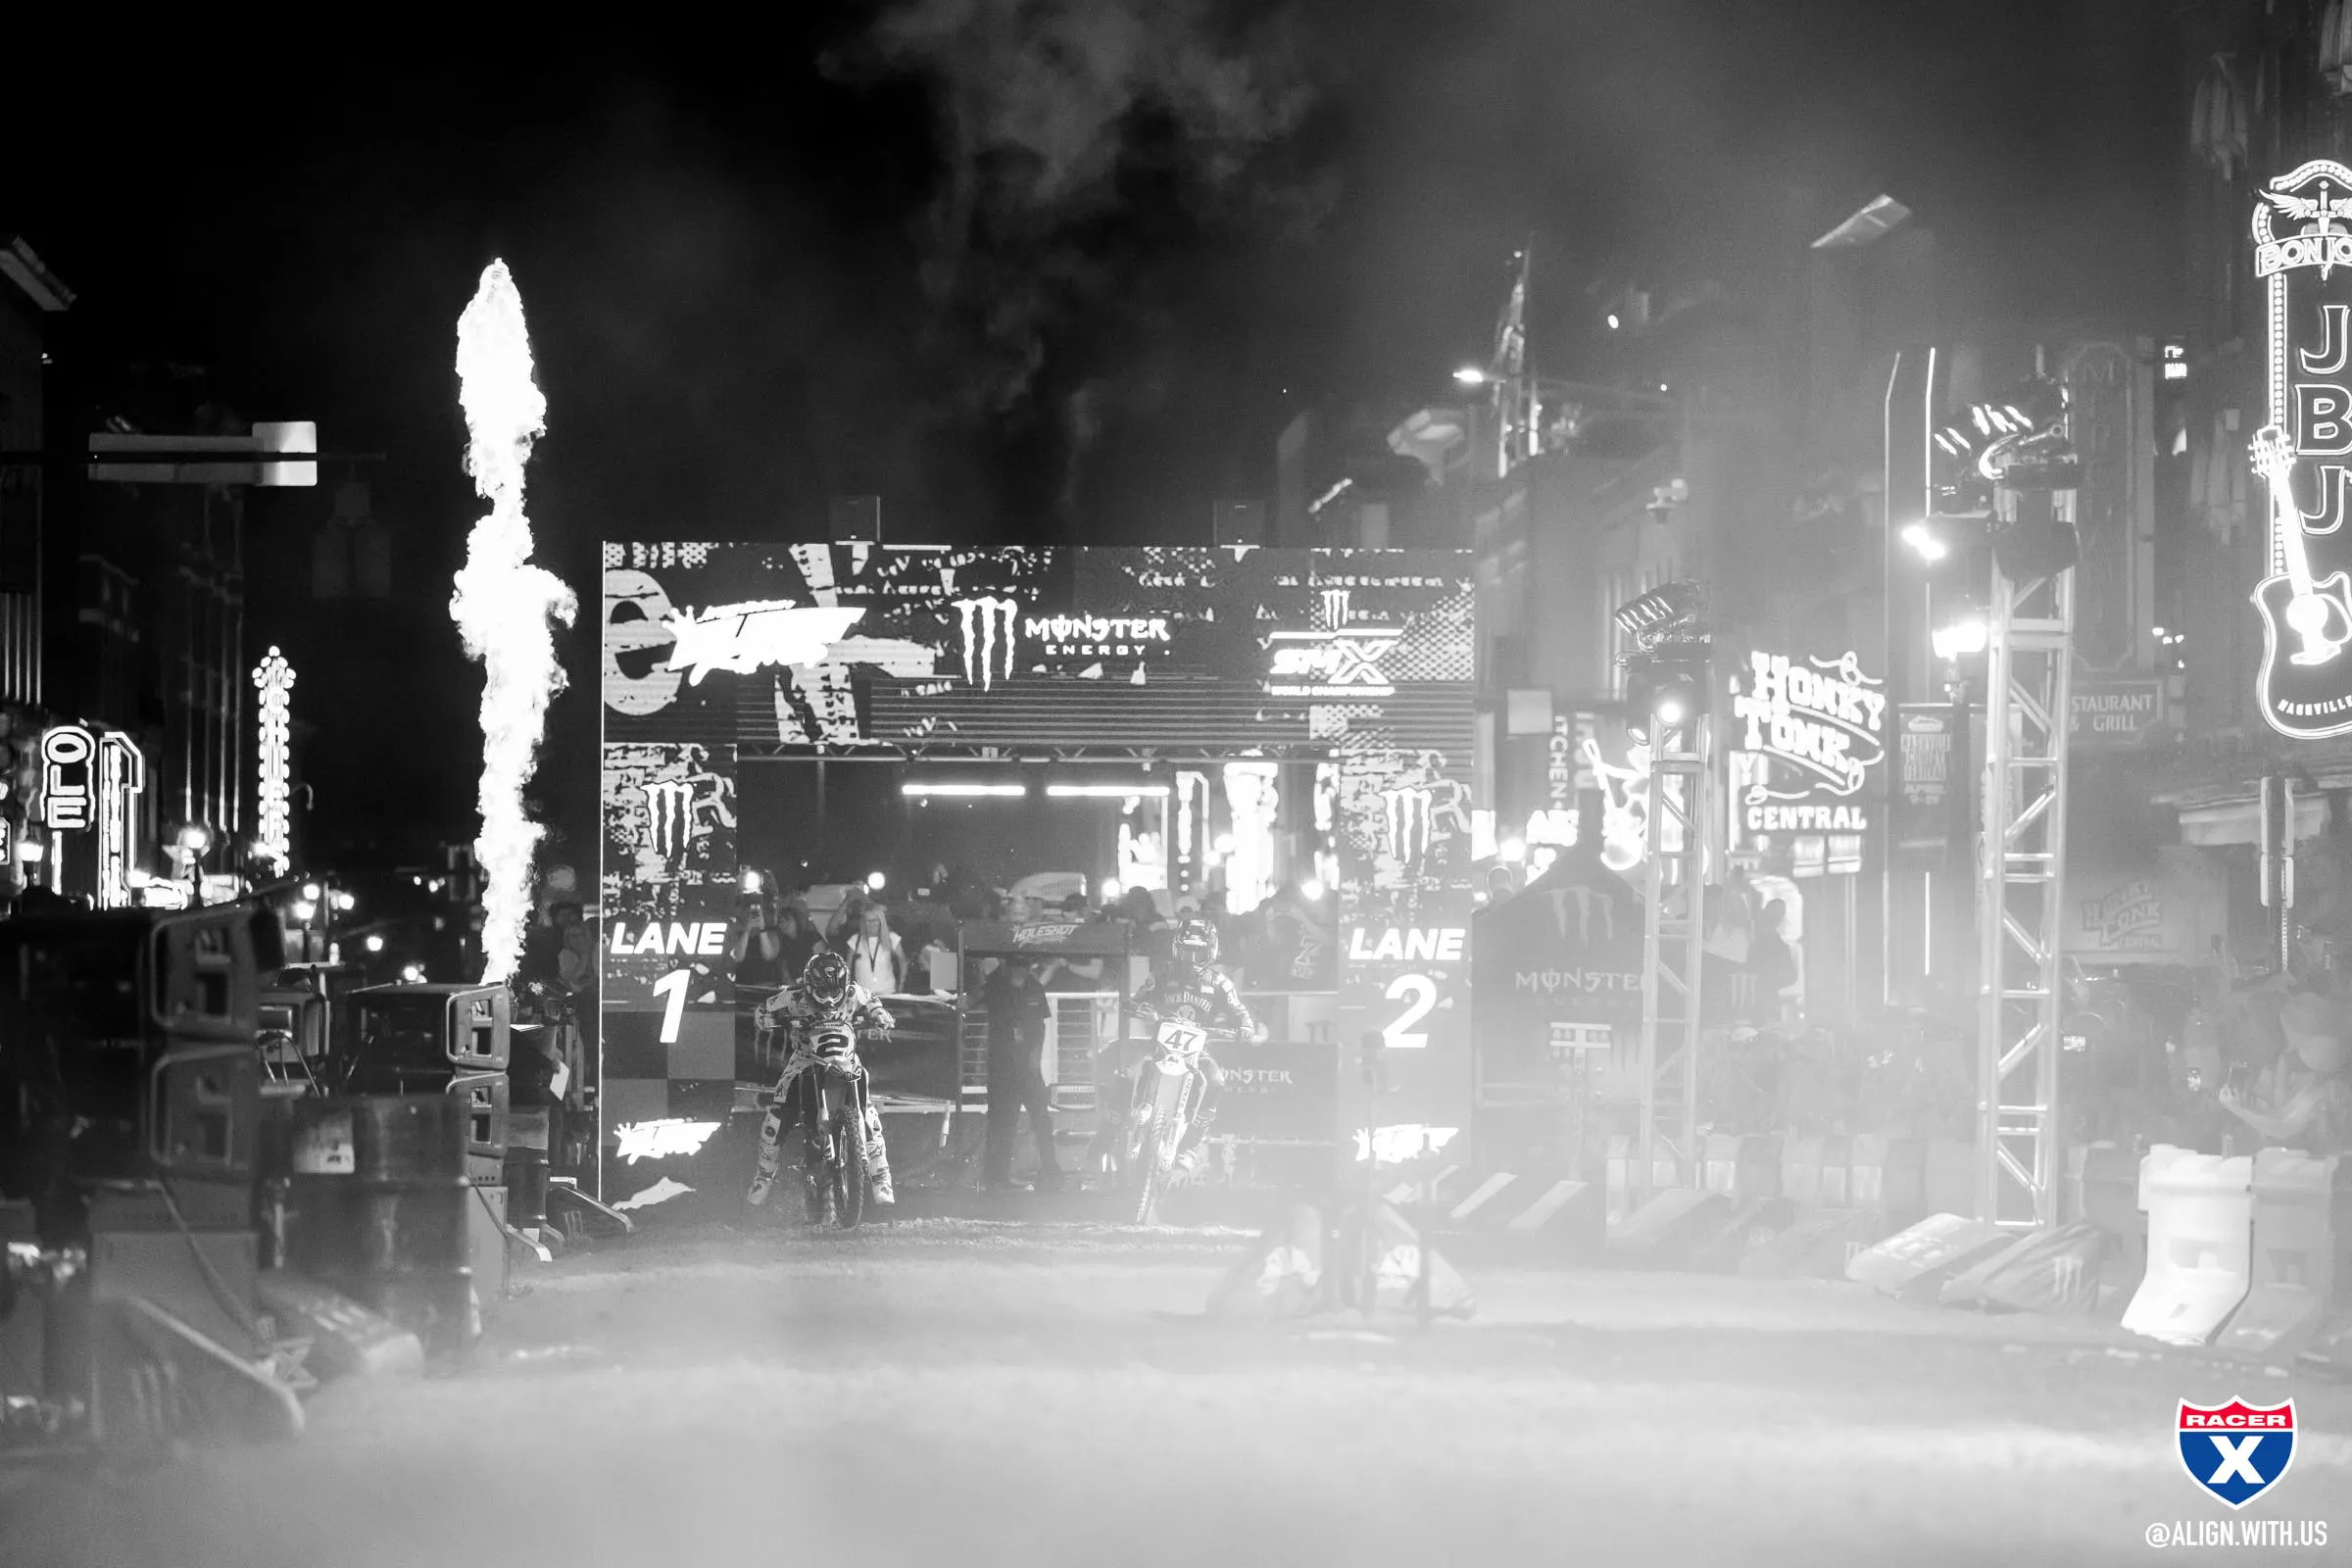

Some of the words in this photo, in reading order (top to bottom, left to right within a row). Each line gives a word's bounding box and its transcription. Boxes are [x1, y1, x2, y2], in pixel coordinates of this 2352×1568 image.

[1025, 613, 1170, 642] MONSTER
[1046, 645, 1146, 656] ENERGY
[1270, 639, 1398, 684] SMX
[1750, 651, 1886, 731] HONKY
[2071, 693, 2154, 713] STAURANT
[1734, 695, 1851, 772] TONK
[2092, 713, 2139, 733] GRILL
[1548, 715, 1569, 799] ITCHEN
[1746, 806, 1867, 830] CENTRAL
[610, 922, 727, 955] LANE
[1348, 928, 1466, 960] LANE
[1514, 968, 1646, 992] MONSTE
[653, 969, 691, 1043] 1
[1384, 974, 1437, 1048] 2
[814, 1032, 850, 1059] 2
[1164, 1030, 1199, 1053] 47
